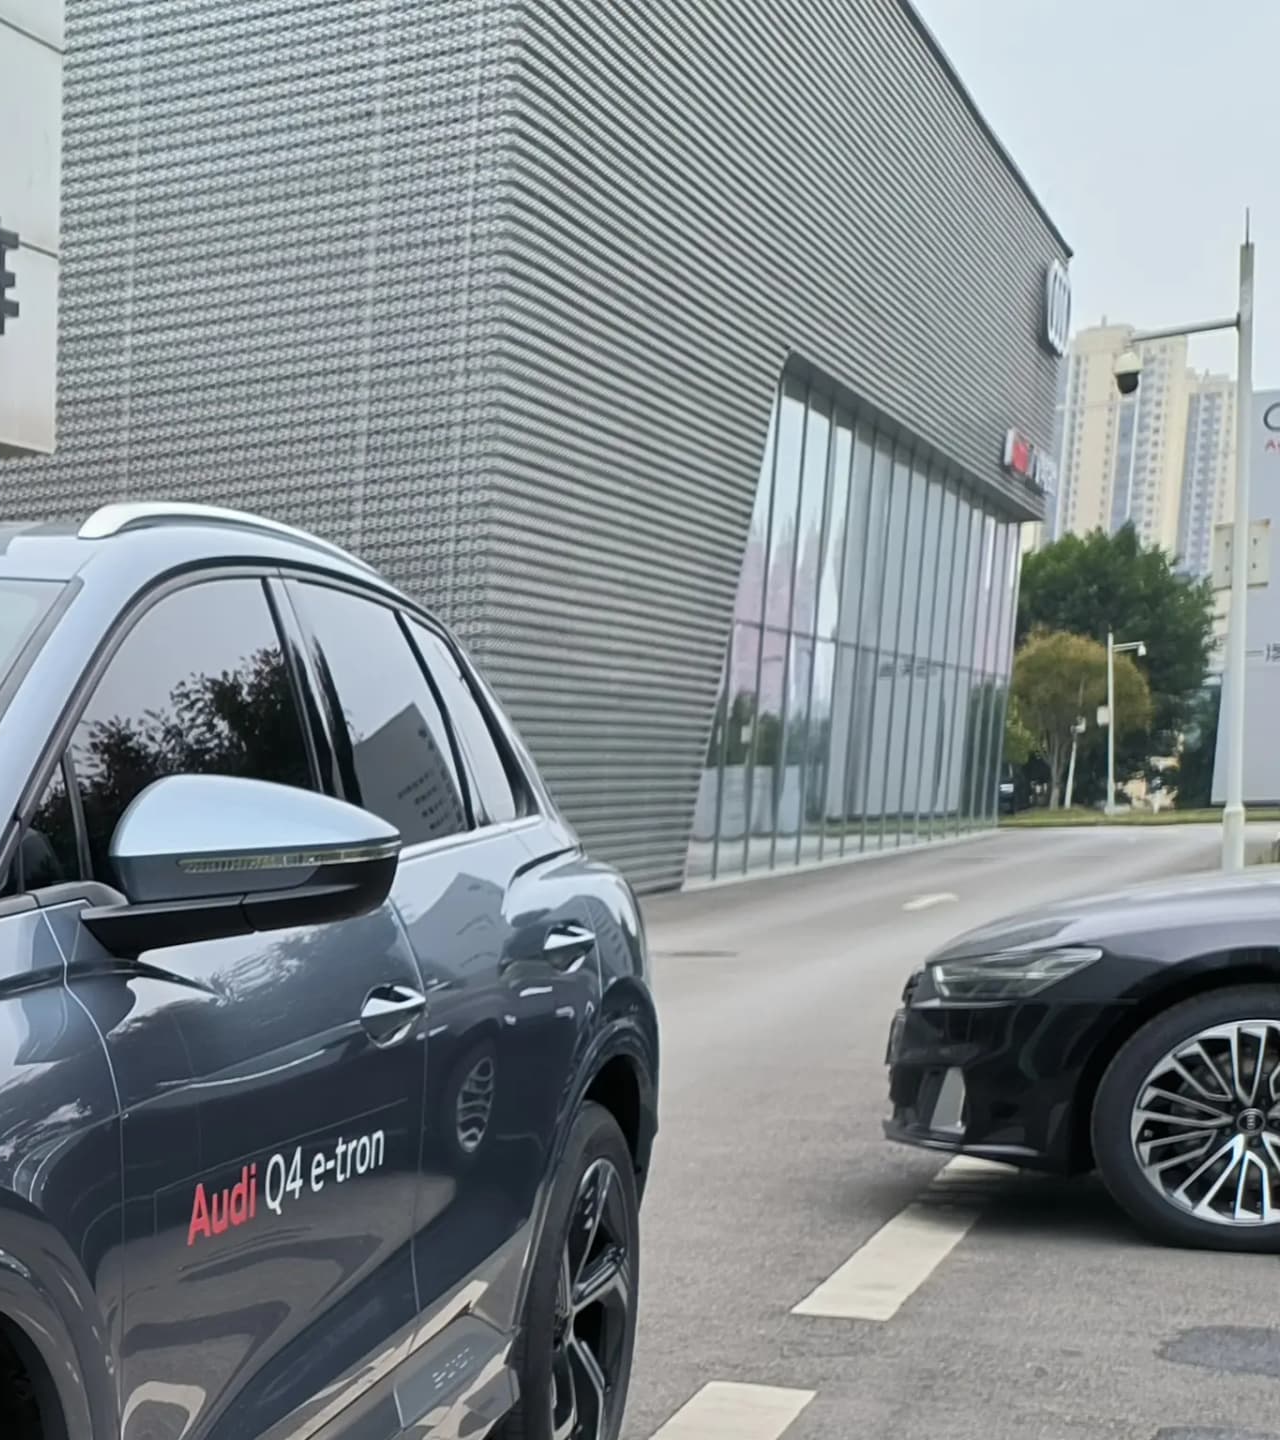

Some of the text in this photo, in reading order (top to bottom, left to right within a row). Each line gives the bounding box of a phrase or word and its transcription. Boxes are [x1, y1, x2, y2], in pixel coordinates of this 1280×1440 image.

[187, 1129, 385, 1246] Audi Q4 e-tron
